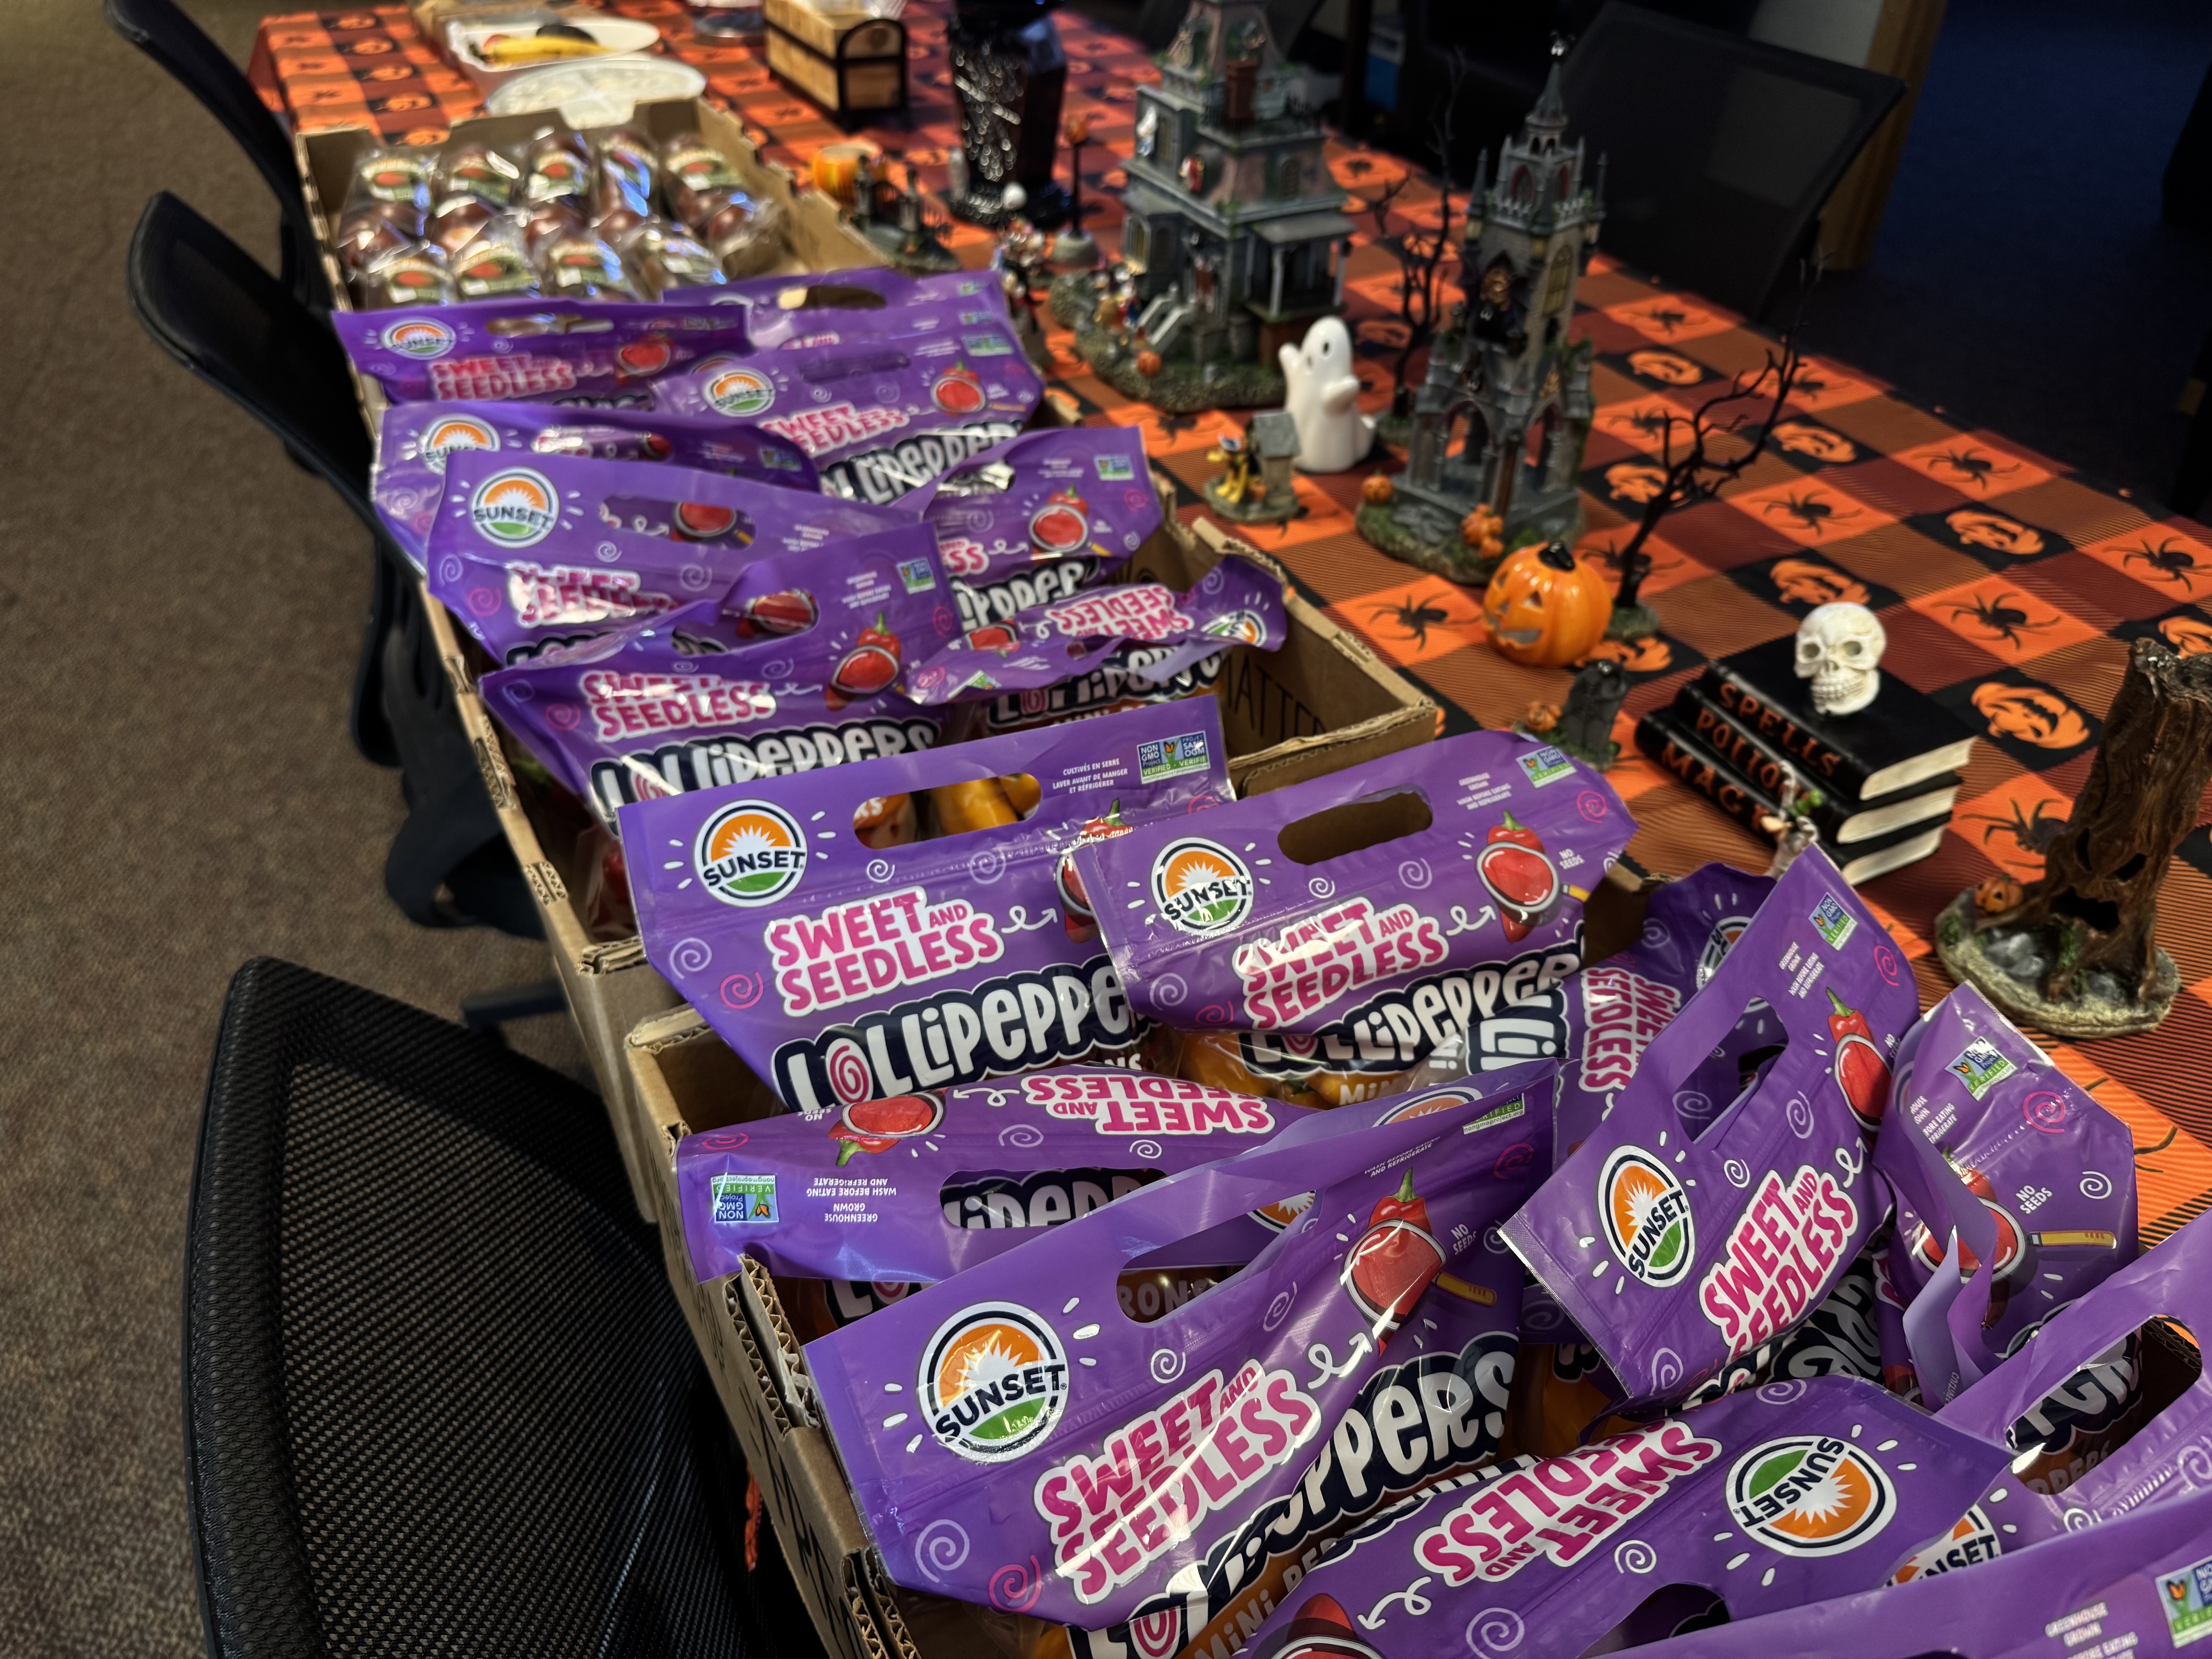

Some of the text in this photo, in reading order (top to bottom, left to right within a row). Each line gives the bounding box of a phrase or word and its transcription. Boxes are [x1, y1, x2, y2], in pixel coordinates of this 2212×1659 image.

[473, 506, 555, 531] SUNSET
[1718, 683, 1841, 777] SPELLS
[1141, 744, 1158, 754] NON
[1142, 751, 1159, 761] GMO
[1184, 747, 1205, 757] OGM
[1696, 708, 1803, 802] POTIO
[1102, 758, 1120, 768] SERRE
[1144, 765, 1171, 776] VERIFIED
[1053, 779, 1071, 790] LAVER
[1072, 776, 1092, 785] AVANT
[1102, 768, 1128, 779] MANGER
[1559, 848, 1574, 860] NO
[1559, 855, 1585, 869] SEEDS
[703, 850, 807, 887] SUNSET
[1164, 878, 1251, 921] SUNSET
[1821, 897, 1833, 911] NON
[1826, 904, 1838, 917] GMO
[772, 891, 968, 967] SWEET AND
[1827, 915, 1848, 942] VERIFIED
[1238, 903, 1415, 992] SWEET AND
[781, 918, 998, 1010] SEEDLESS
[1796, 965, 1810, 984] BEFORE
[1247, 923, 1443, 1029] SEEDLESS
[1884, 1033, 1896, 1048] NO
[1968, 1060, 2005, 1091] VERIFIED
[805, 1113, 823, 1121] NO
[1054, 1099, 1271, 1133] SWEET AND
[1463, 1109, 1523, 1133] nongmoproject.org
[1914, 1108, 1930, 1124] OWN
[870, 1178, 888, 1186] AND
[1370, 1165, 1386, 1177] AND
[838, 1188, 870, 1197] BEFORE
[872, 1187, 897, 1197] WASH
[2015, 1185, 2036, 1202] NO
[2019, 1187, 2052, 1215] SEEDS
[719, 1202, 744, 1211] GMO
[719, 1210, 744, 1220] NON
[833, 1203, 866, 1212] GROWN
[824, 1213, 878, 1223] GREENHOUSE
[1451, 1224, 1469, 1240] NO
[1453, 1231, 1477, 1255] SEEDS
[1628, 1190, 1685, 1279] SUNSET
[1704, 1171, 1817, 1340] SWEET AND
[1731, 1179, 1853, 1362] SEEDLESS
[936, 1364, 1065, 1440] SUNSET
[1042, 1366, 1261, 1538] SWEET AND
[1063, 1379, 1312, 1595] SEEDLESS
[1743, 1437, 1844, 1528] SUNSET
[1485, 1426, 1716, 1577] SWEET AND
